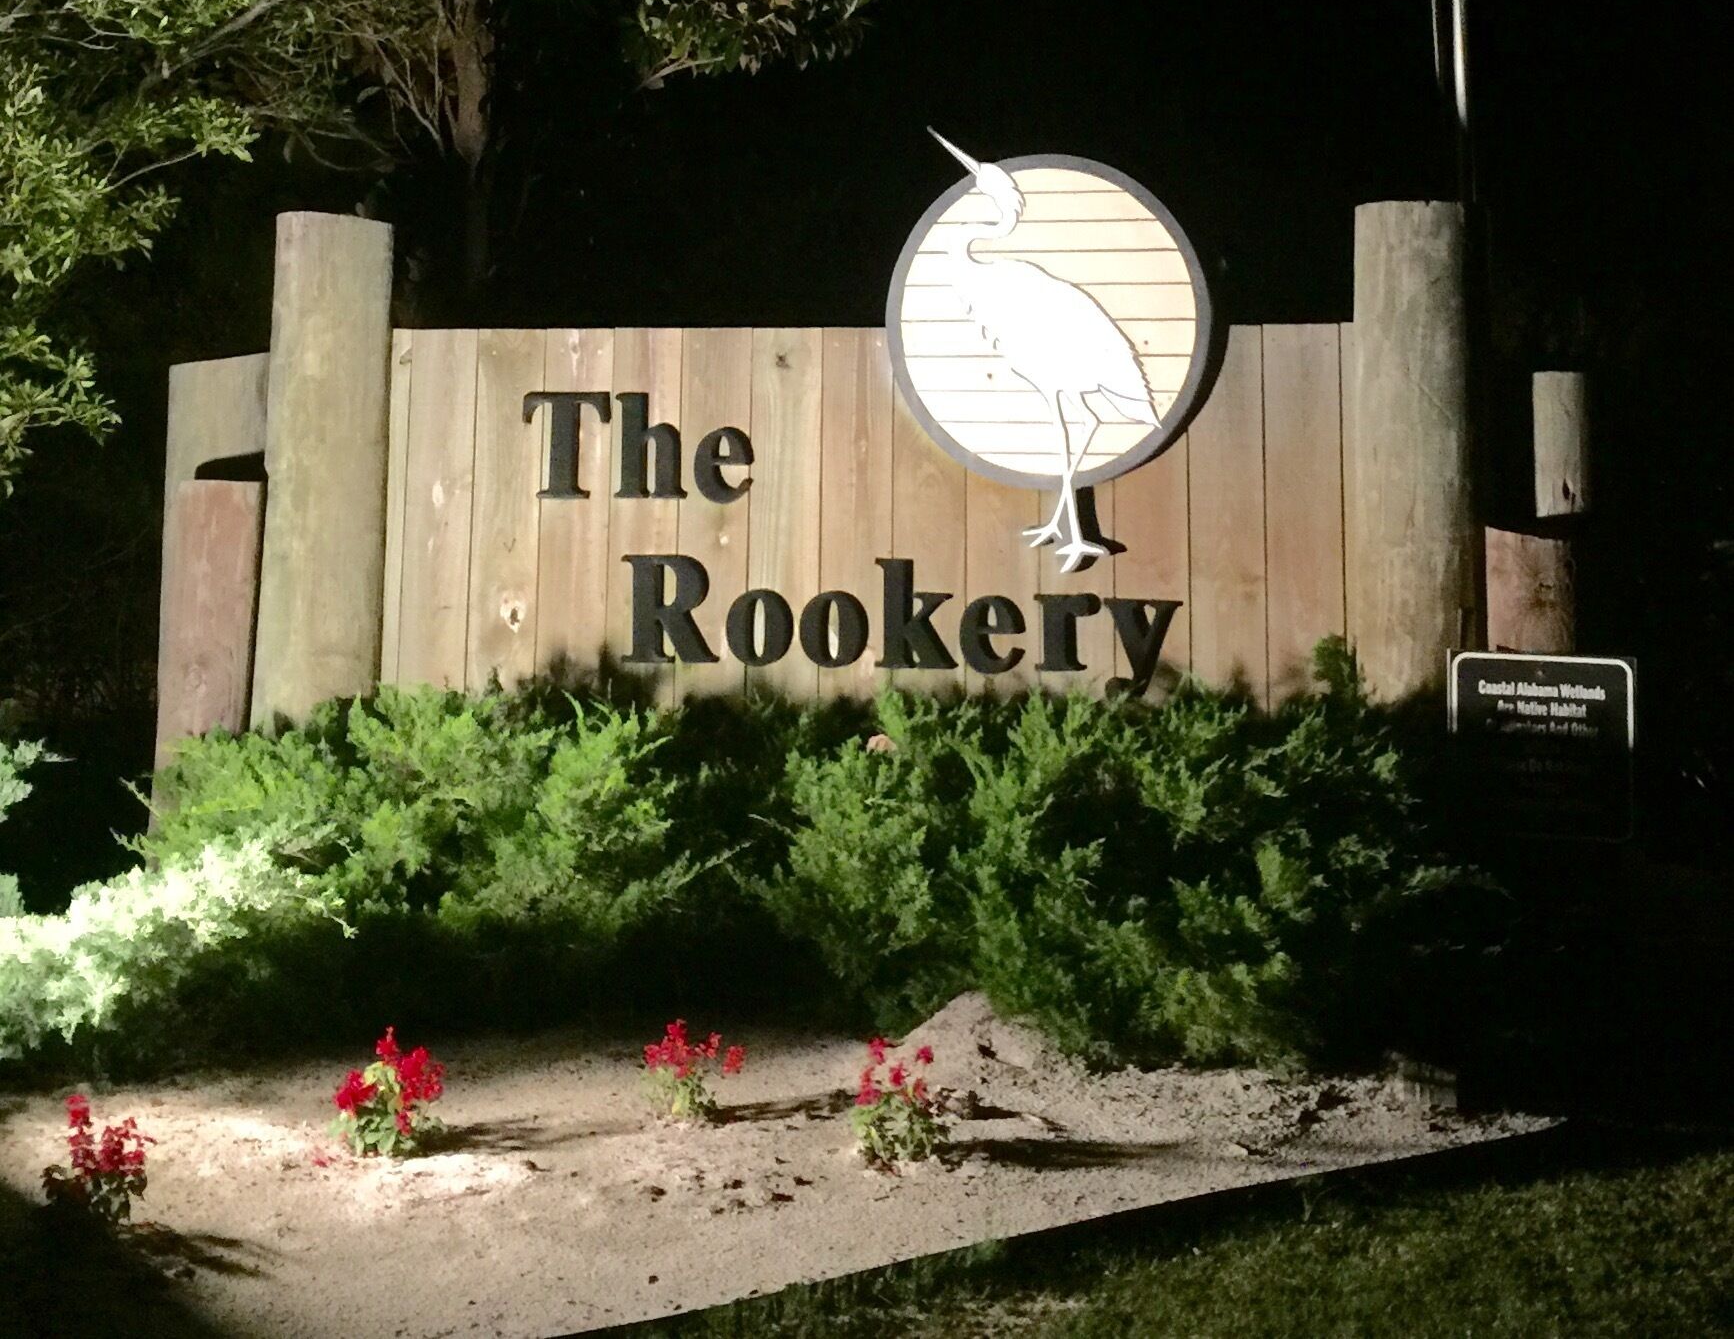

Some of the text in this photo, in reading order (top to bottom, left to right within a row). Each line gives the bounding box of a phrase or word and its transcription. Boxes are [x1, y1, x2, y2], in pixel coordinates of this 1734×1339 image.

[522, 391, 755, 504] The
[621, 554, 1184, 699] Rookery
[1478, 679, 1606, 701] Coastal Alabama Wetlands
[1517, 700, 1548, 716] Native
[1550, 701, 1587, 718] Habitat
